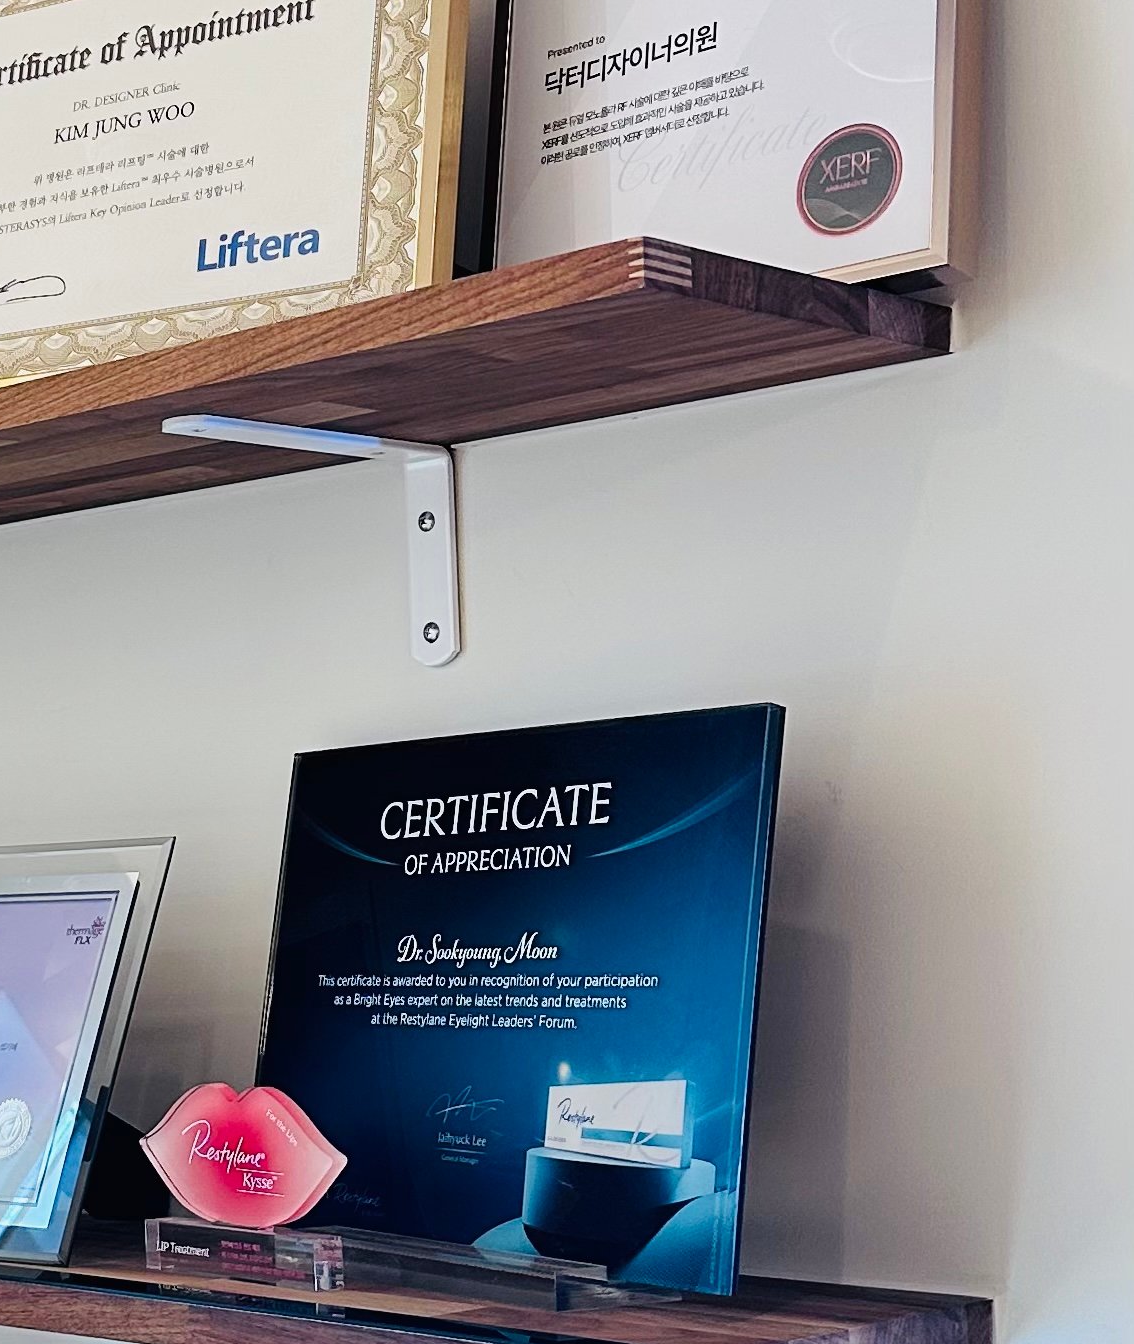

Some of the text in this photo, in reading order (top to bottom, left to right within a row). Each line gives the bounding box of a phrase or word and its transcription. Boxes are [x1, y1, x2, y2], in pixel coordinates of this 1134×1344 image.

[101, 31, 130, 63] of
[545, 22, 717, 95] 닥터디자이너의원
[547, 38, 594, 59] Presented
[95, 81, 181, 106] DESIGNER Clinic
[54, 101, 195, 144] KIM JUNG WOO
[819, 147, 883, 184] XERF
[89, 200, 146, 220] Key Opinion
[197, 226, 320, 273] Liftera
[380, 782, 612, 839] CERTIFICATE
[404, 844, 572, 876] OF APPRECIATION
[74, 936, 92, 945] FLX
[397, 932, 558, 963] Dr. Moon
[318, 973, 658, 991] This certificate is awarded to you in recognition of your participation
[334, 993, 626, 1010] as Bright Eyes expert on the latest trends and treatments
[371, 1012, 577, 1030] at the Restylane Eyelight Leaders' Forum.
[181, 1119, 265, 1174] Restylane
[472, 1135, 487, 1147] Lee
[243, 1172, 277, 1191] Kysse
[156, 1240, 210, 1258] LIP Treatment
